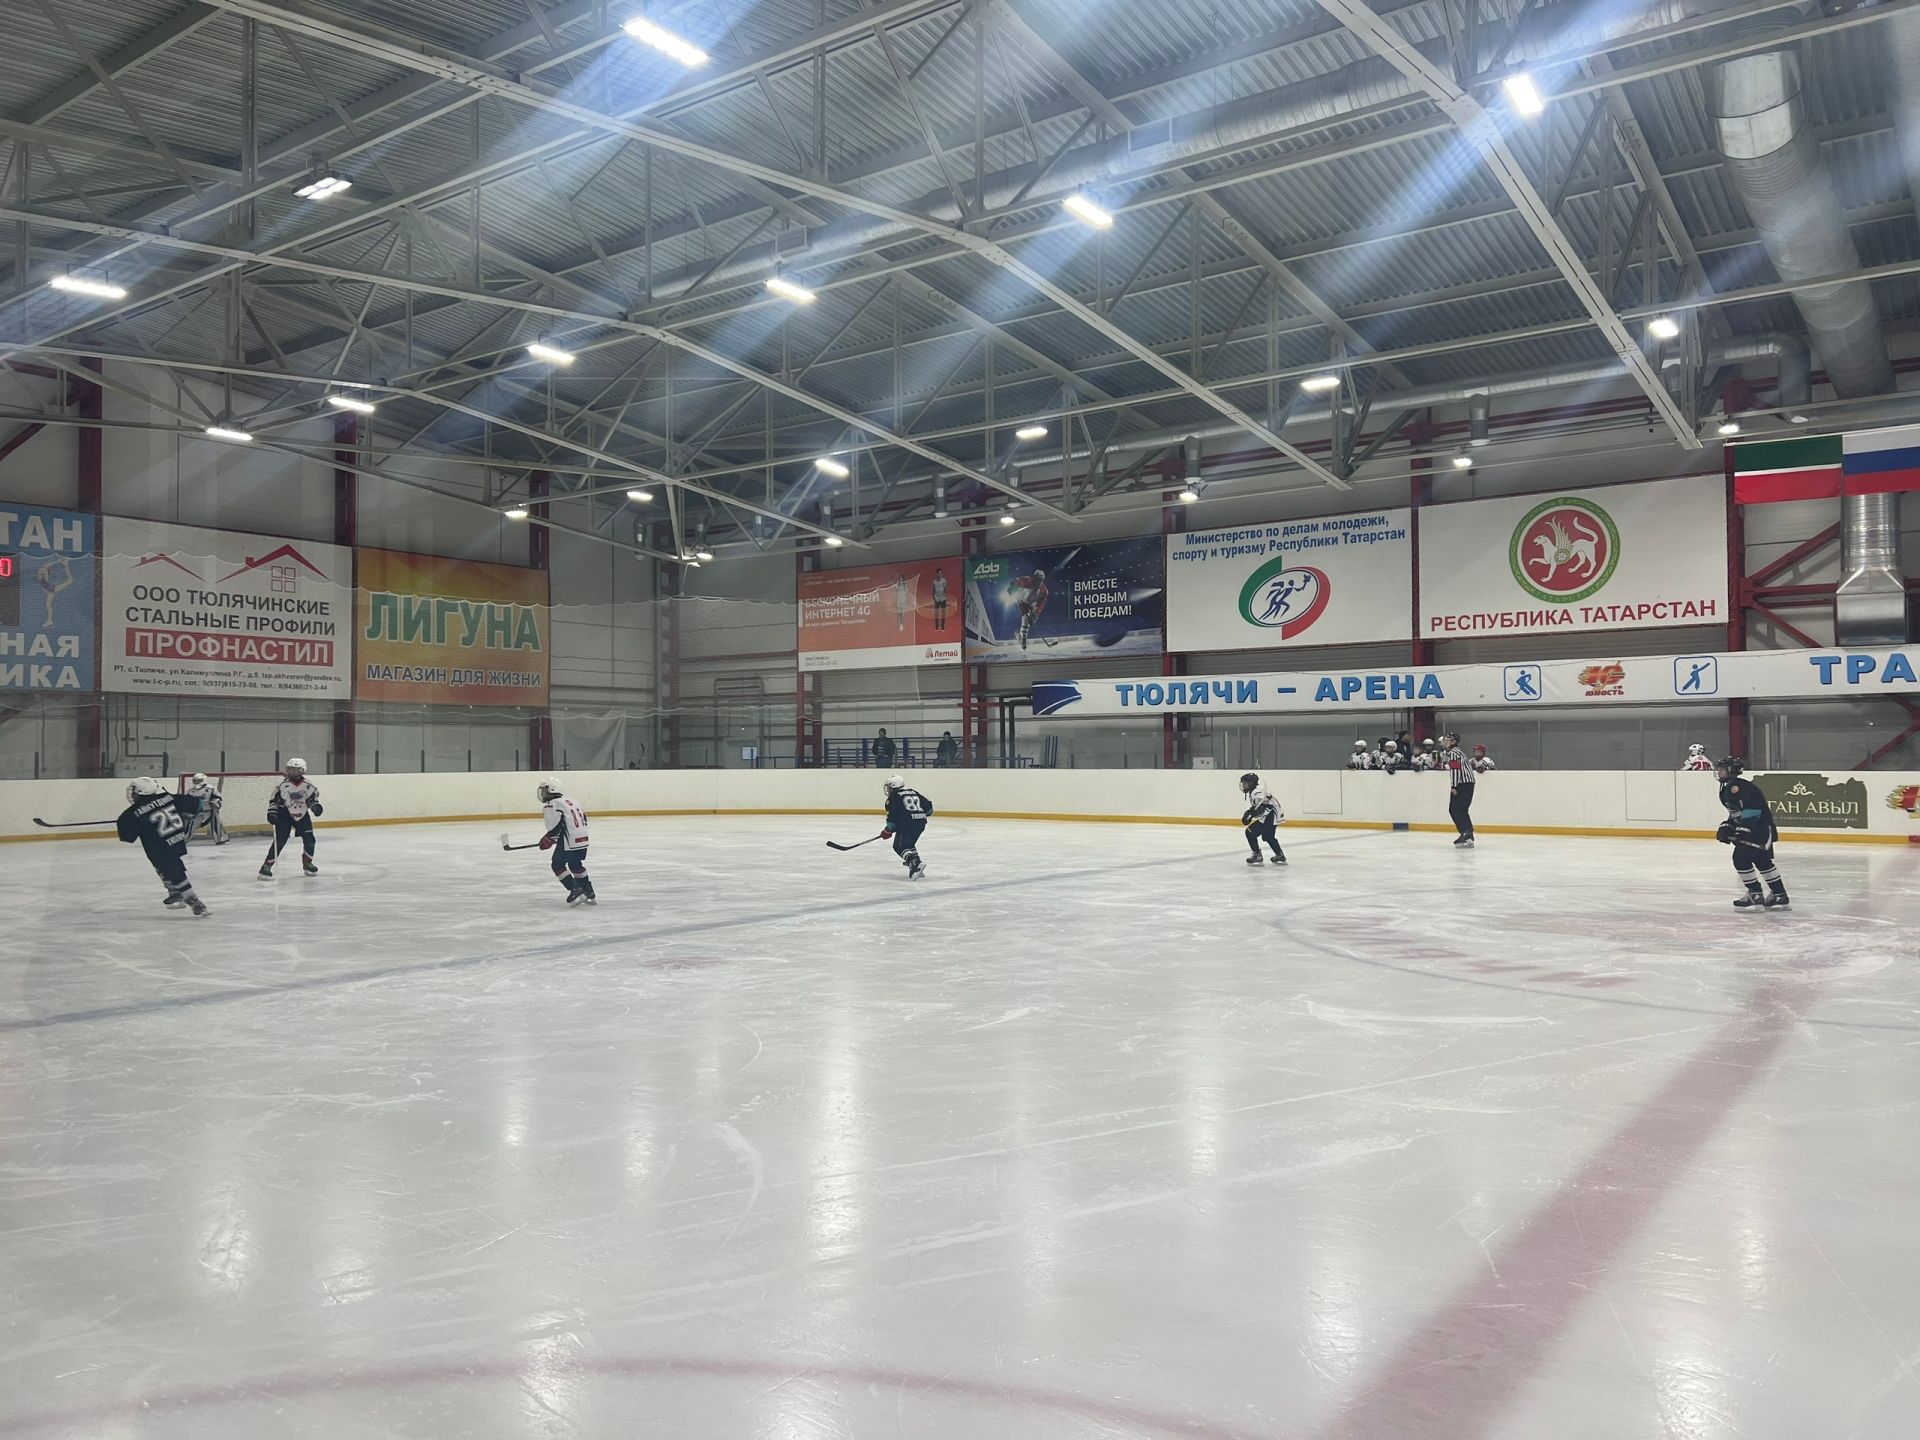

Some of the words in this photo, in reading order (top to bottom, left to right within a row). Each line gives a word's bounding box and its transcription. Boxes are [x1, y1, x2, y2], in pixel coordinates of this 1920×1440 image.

[1172, 549, 1208, 562] спорту
[1210, 547, 1218, 558] и
[1220, 542, 1266, 559] туризму
[1269, 534, 1339, 553] Республики
[1342, 528, 1406, 545] Татарстан
[1185, 528, 1263, 546] Министерство
[1266, 528, 1280, 539] по
[1282, 523, 1320, 537] делам
[1322, 515, 1389, 533] молодежи,
[132, 584, 181, 605] ООО
[187, 589, 331, 616] ТЮЛЯЧИНСКИЕ
[1074, 577, 1118, 592] ВМЕСТЕ
[1074, 595, 1082, 605] К
[1083, 591, 1128, 604] НОВЫМ
[125, 606, 241, 631] СТАЛЬНЫЕ
[246, 616, 336, 637] ПРОФИЛИ
[364, 590, 542, 652] ЛИГУНА
[804, 606, 855, 621] ИНТЕРНЕТ
[856, 606, 871, 617] 4G
[1074, 605, 1133, 620] ПОБЕДАМ!
[1431, 608, 1574, 632] РЕСПУБЛИКА
[1579, 599, 1717, 624] ТАТАРСТАН
[0, 631, 81, 659] НАЯ
[133, 630, 330, 665] ПРОФНАСТИЛ
[366, 663, 447, 683] МАГАЗИН
[450, 669, 485, 687] ДЛЯ
[488, 670, 542, 688] ЖИЗНИ
[1809, 652, 1918, 686] ТРА
[1115, 680, 1259, 707] ТЮЛЯЧИ
[1315, 673, 1445, 702] АРЕНА
[149, 803, 184, 838] 25
